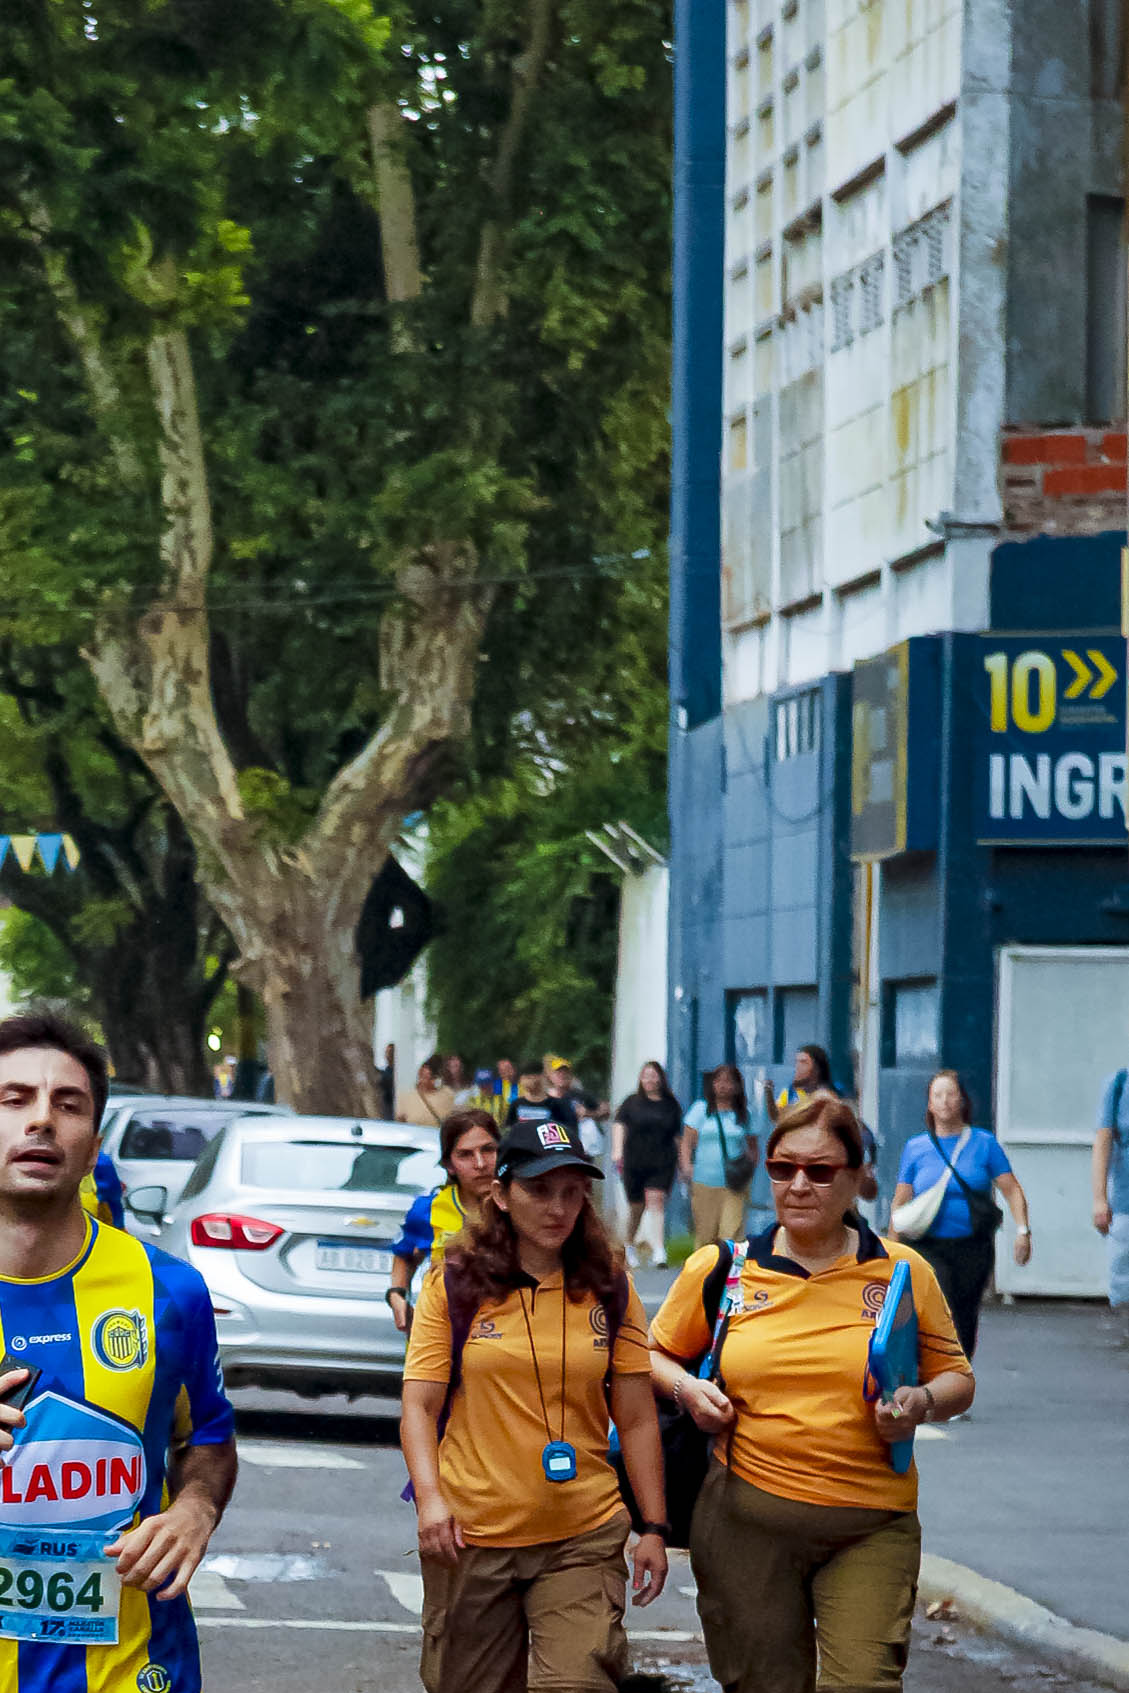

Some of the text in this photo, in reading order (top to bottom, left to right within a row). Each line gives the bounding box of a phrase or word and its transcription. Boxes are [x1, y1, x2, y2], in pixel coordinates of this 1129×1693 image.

[984, 651, 1057, 733] 10
[29, 1333, 72, 1345] express
[40, 1541, 77, 1557] RUS
